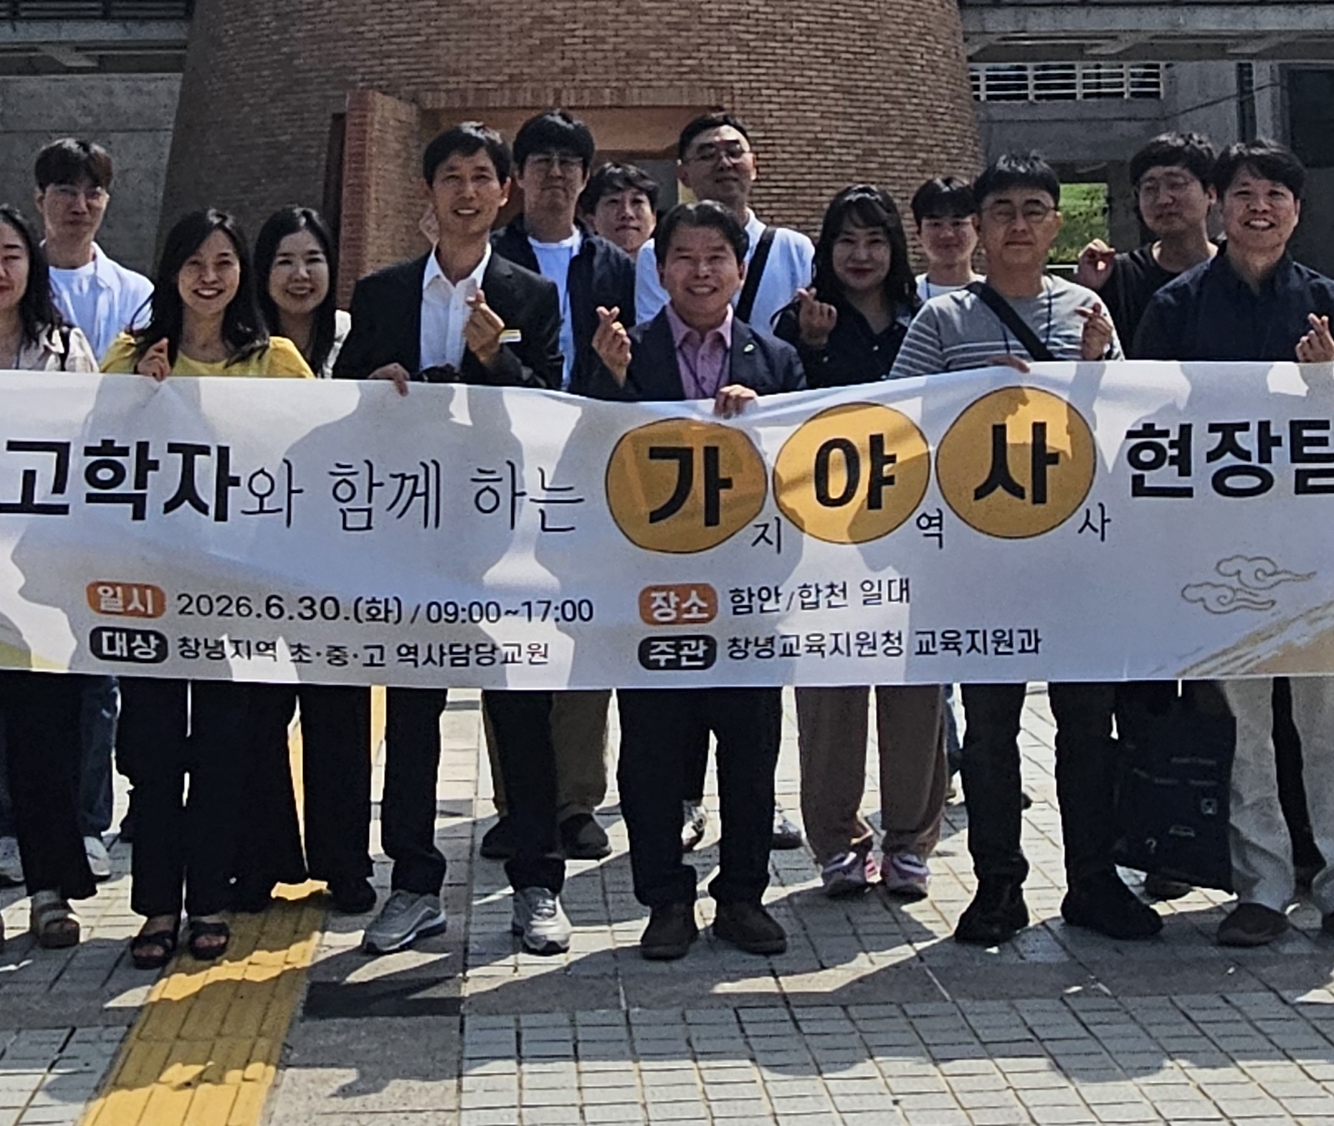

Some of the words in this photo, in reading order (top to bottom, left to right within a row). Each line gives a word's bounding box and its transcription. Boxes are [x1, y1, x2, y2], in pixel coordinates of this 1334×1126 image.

[328, 459, 441, 532] 함께
[470, 459, 585, 533] 하는
[97, 585, 153, 614] 일시
[650, 590, 709, 621] 장소
[728, 581, 849, 616] 함안/합천
[860, 577, 911, 606] 일대
[101, 631, 160, 659] 대상
[178, 636, 278, 662] 창녕지역
[396, 642, 549, 668] 역사담당교원
[649, 639, 709, 667] 주관
[727, 629, 904, 660] 창녕교육지원청
[914, 628, 1042, 657] 교육지원과
